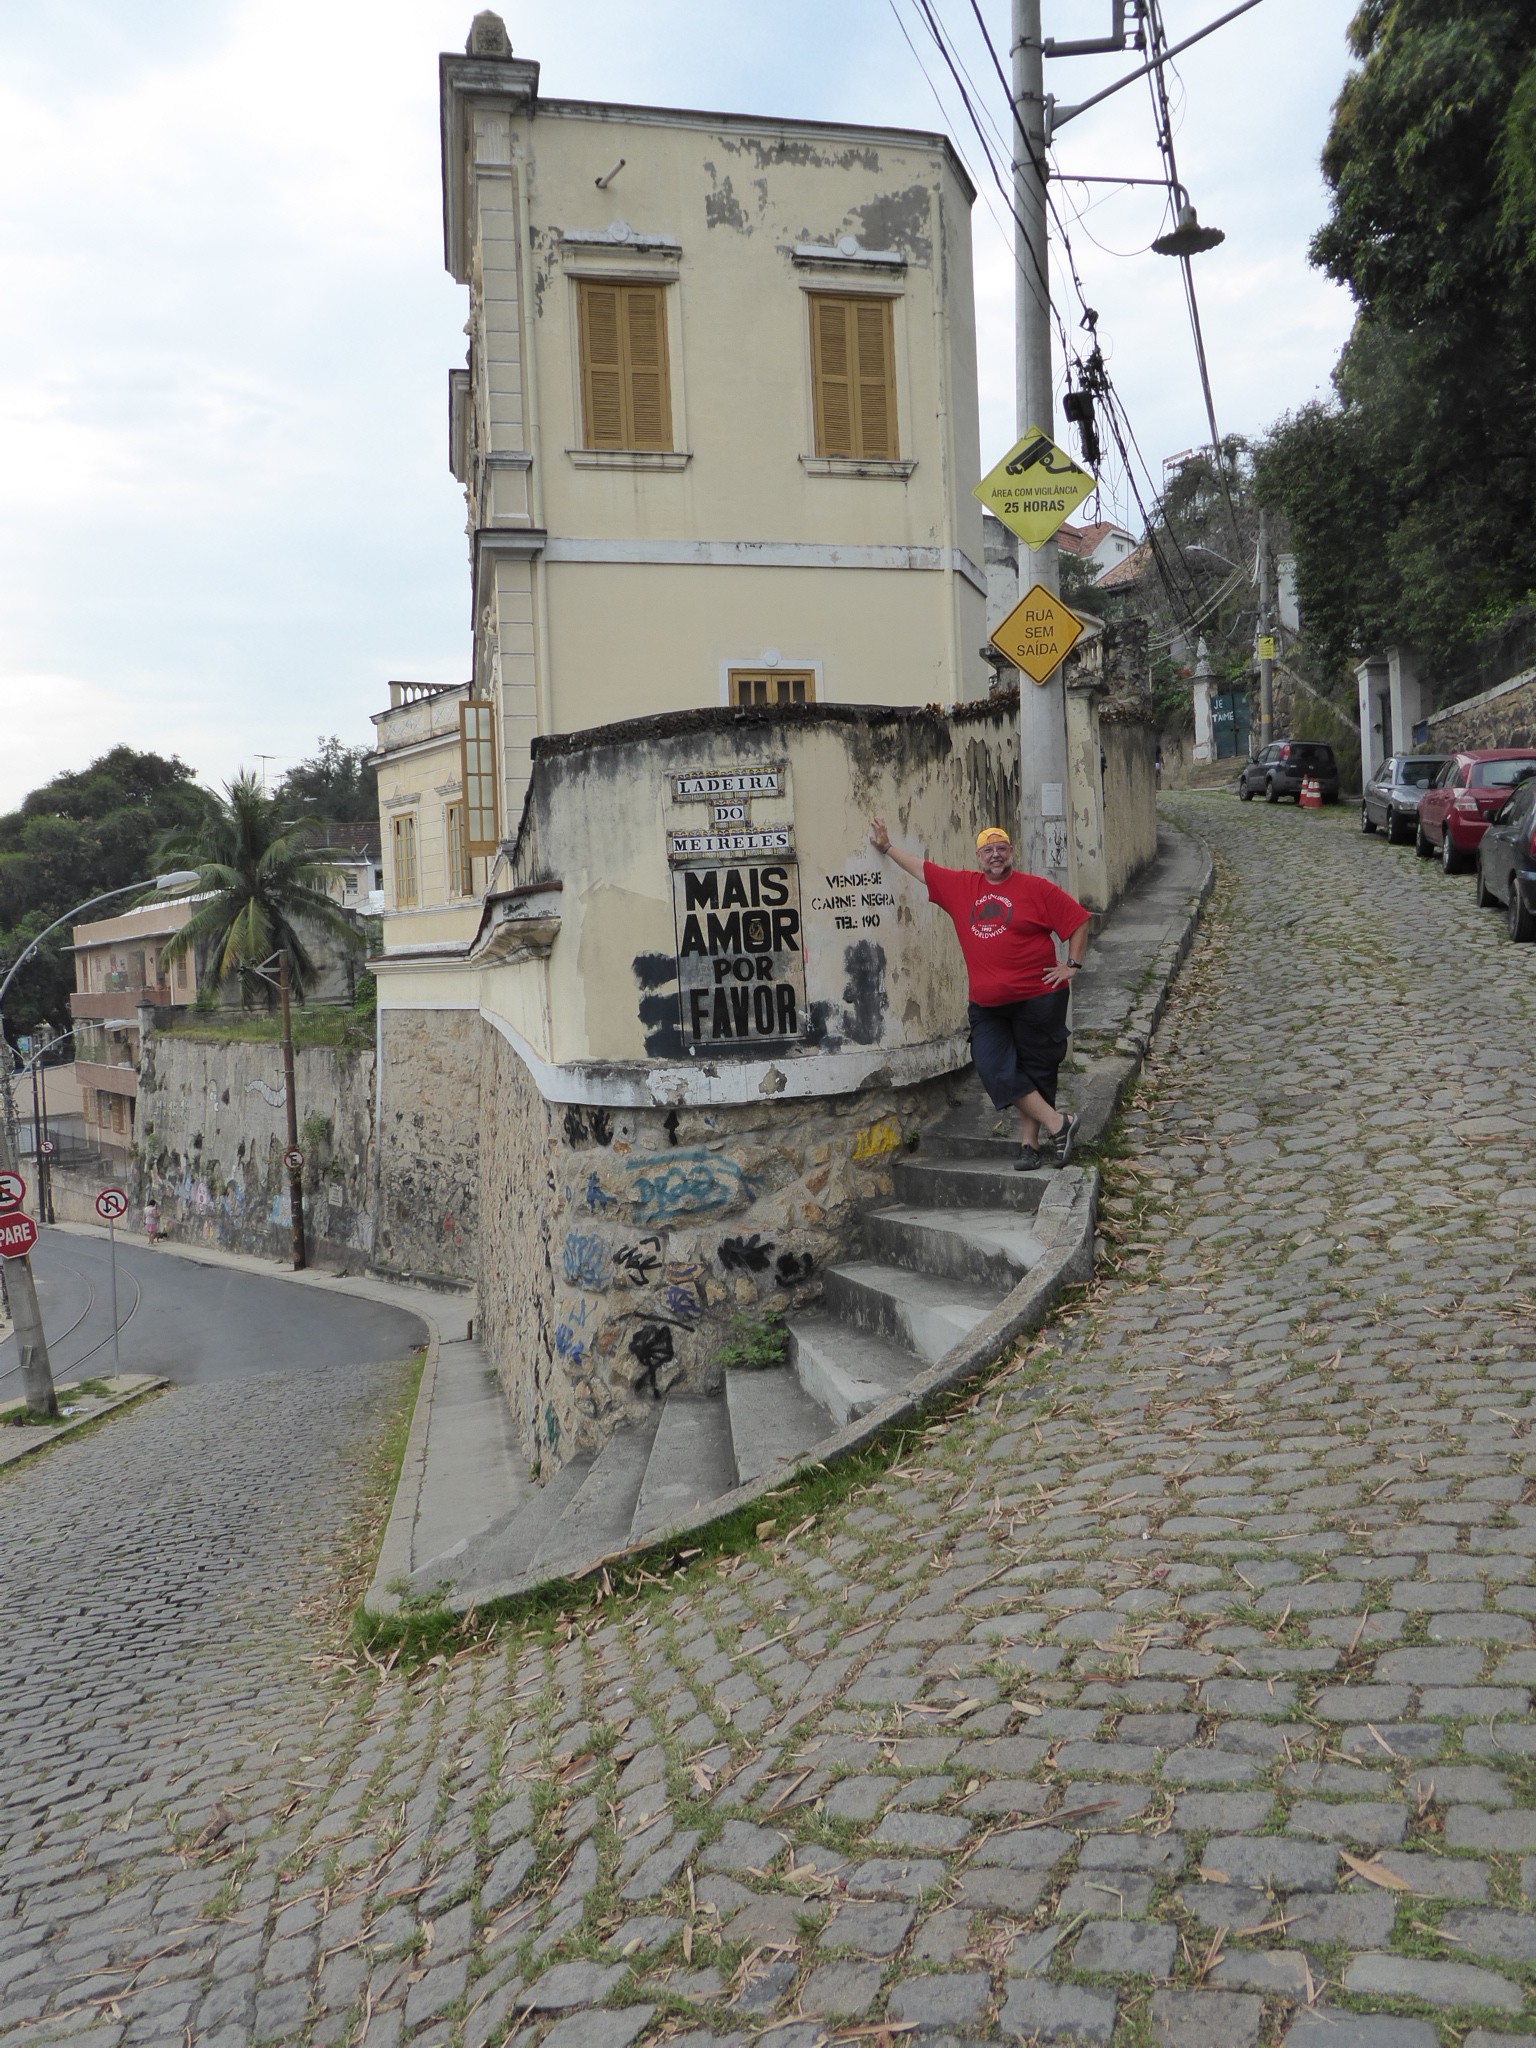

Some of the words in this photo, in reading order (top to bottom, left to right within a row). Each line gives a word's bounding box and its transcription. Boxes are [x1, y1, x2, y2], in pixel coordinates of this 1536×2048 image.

[992, 488, 1013, 498] ÁREA
[1014, 488, 1033, 497] COM
[1034, 485, 1078, 496] VIGILÂNCIA
[1004, 502, 1019, 513] 25
[1023, 500, 1065, 513] HORAS
[1026, 609, 1054, 622] RUA
[1025, 625, 1054, 639] SEM
[1016, 640, 1059, 657] SAÍDA
[1214, 699, 1224, 709] JE
[680, 776, 776, 794] LADEIRA
[716, 808, 743, 820] DO
[674, 833, 788, 852] MEIRELES
[825, 872, 882, 889] VENDE-SE
[684, 867, 789, 912] MAIS
[811, 894, 857, 911] CARNE
[861, 892, 895, 907] NEGRA
[861, 913, 881, 928] 190
[680, 908, 801, 958] AMOR
[712, 956, 774, 985] POR
[690, 984, 798, 1040] FAVOR
[0, 1222, 32, 1247] PARE
